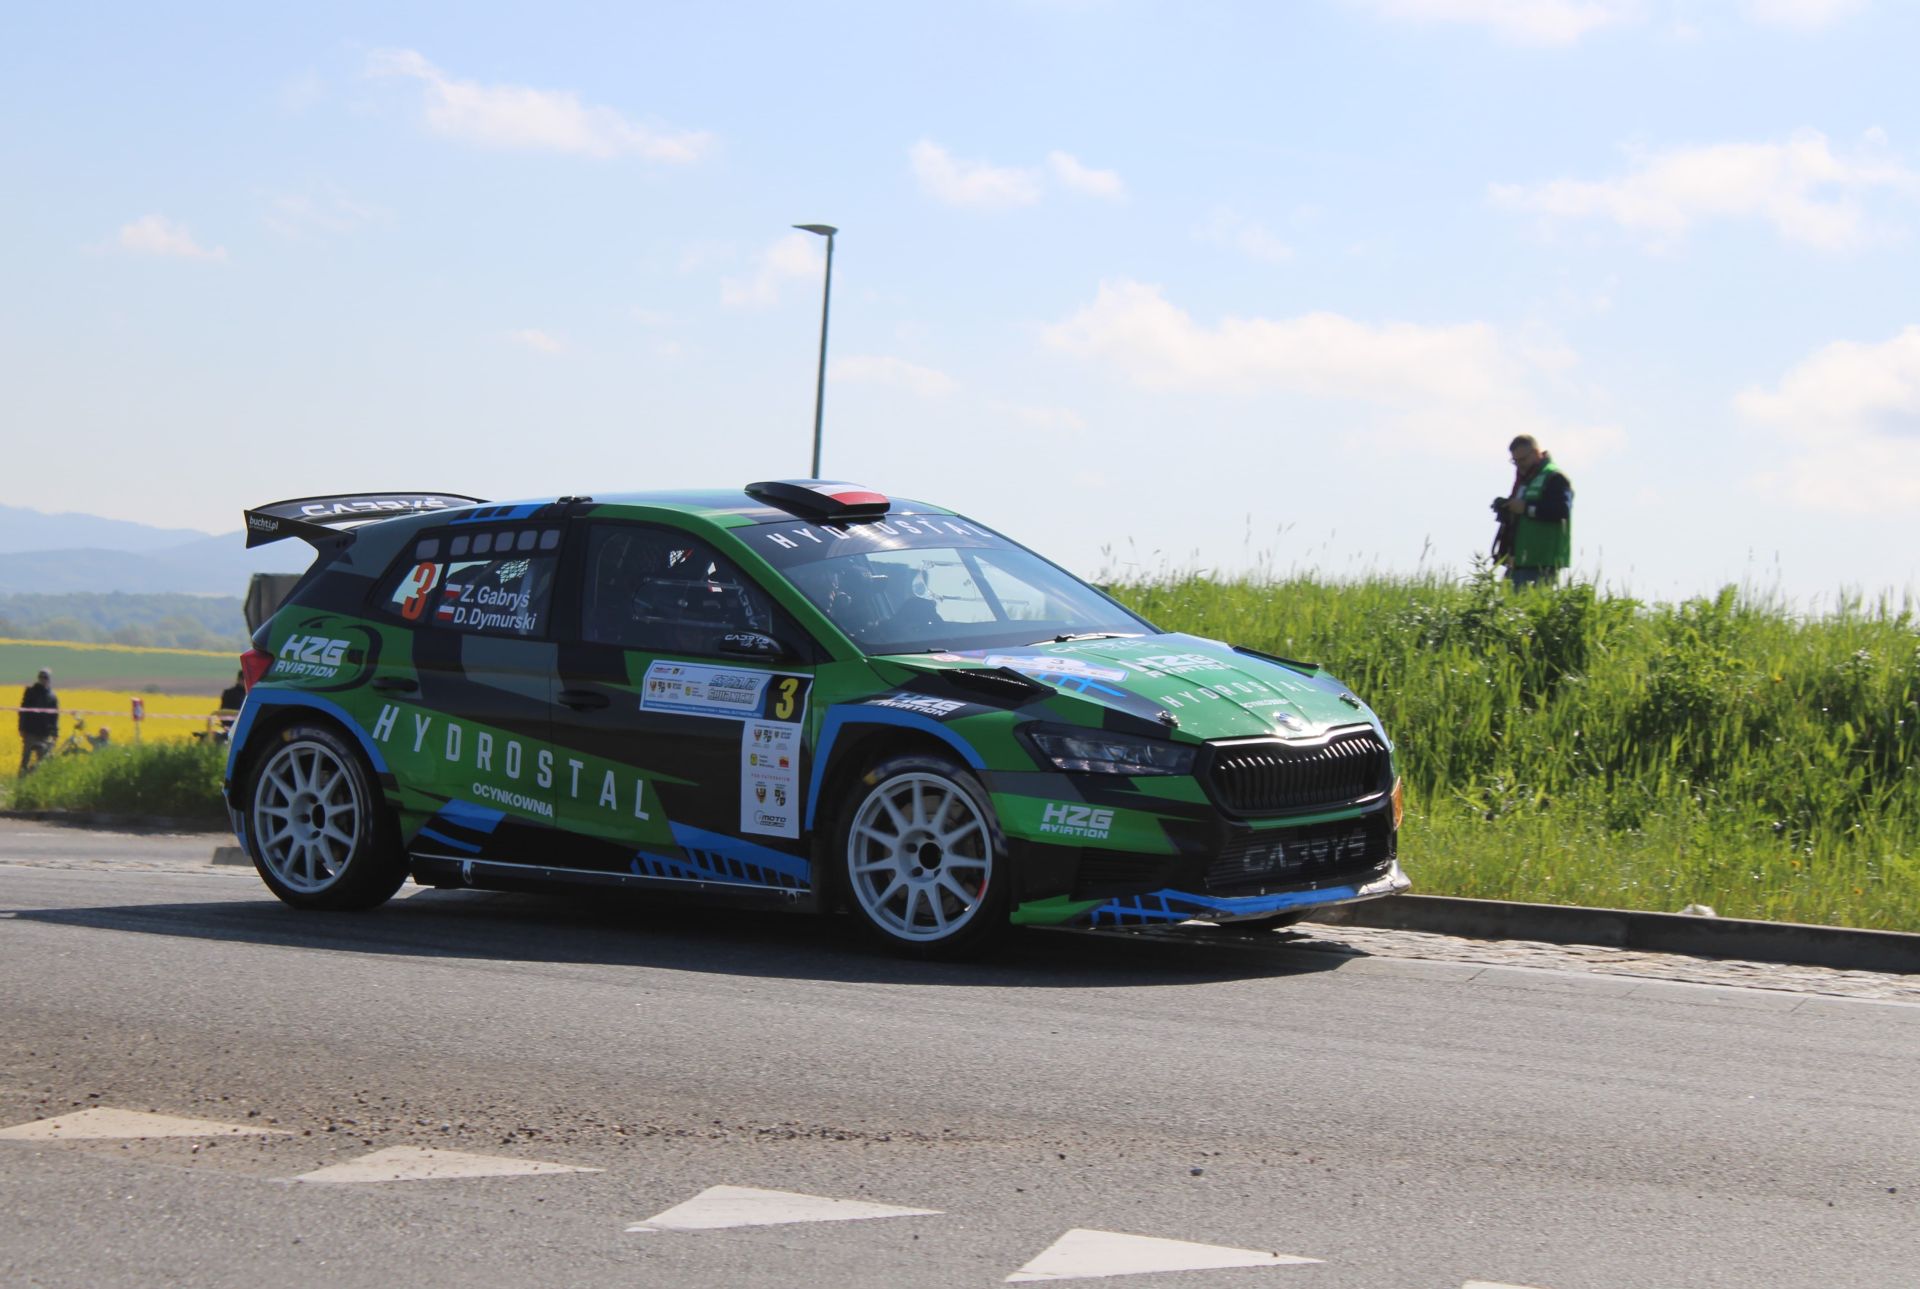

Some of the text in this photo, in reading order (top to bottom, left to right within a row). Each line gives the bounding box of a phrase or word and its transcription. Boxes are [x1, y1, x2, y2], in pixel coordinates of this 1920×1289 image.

[249, 514, 279, 532] buchti.pl
[402, 562, 436, 621] 3
[460, 584, 530, 608] Z. Gabryś
[453, 608, 537, 630] D. Dymurski
[279, 634, 351, 666] HZG
[275, 660, 338, 678] AVIATION
[775, 678, 799, 719] 3
[890, 693, 967, 711] HZG
[373, 703, 649, 821] HYDROSTAL
[472, 782, 553, 818] OCYNKOWNIA
[762, 814, 787, 823] MOTO
[1042, 802, 1114, 830] HZG
[1040, 823, 1109, 839] AVIATION
